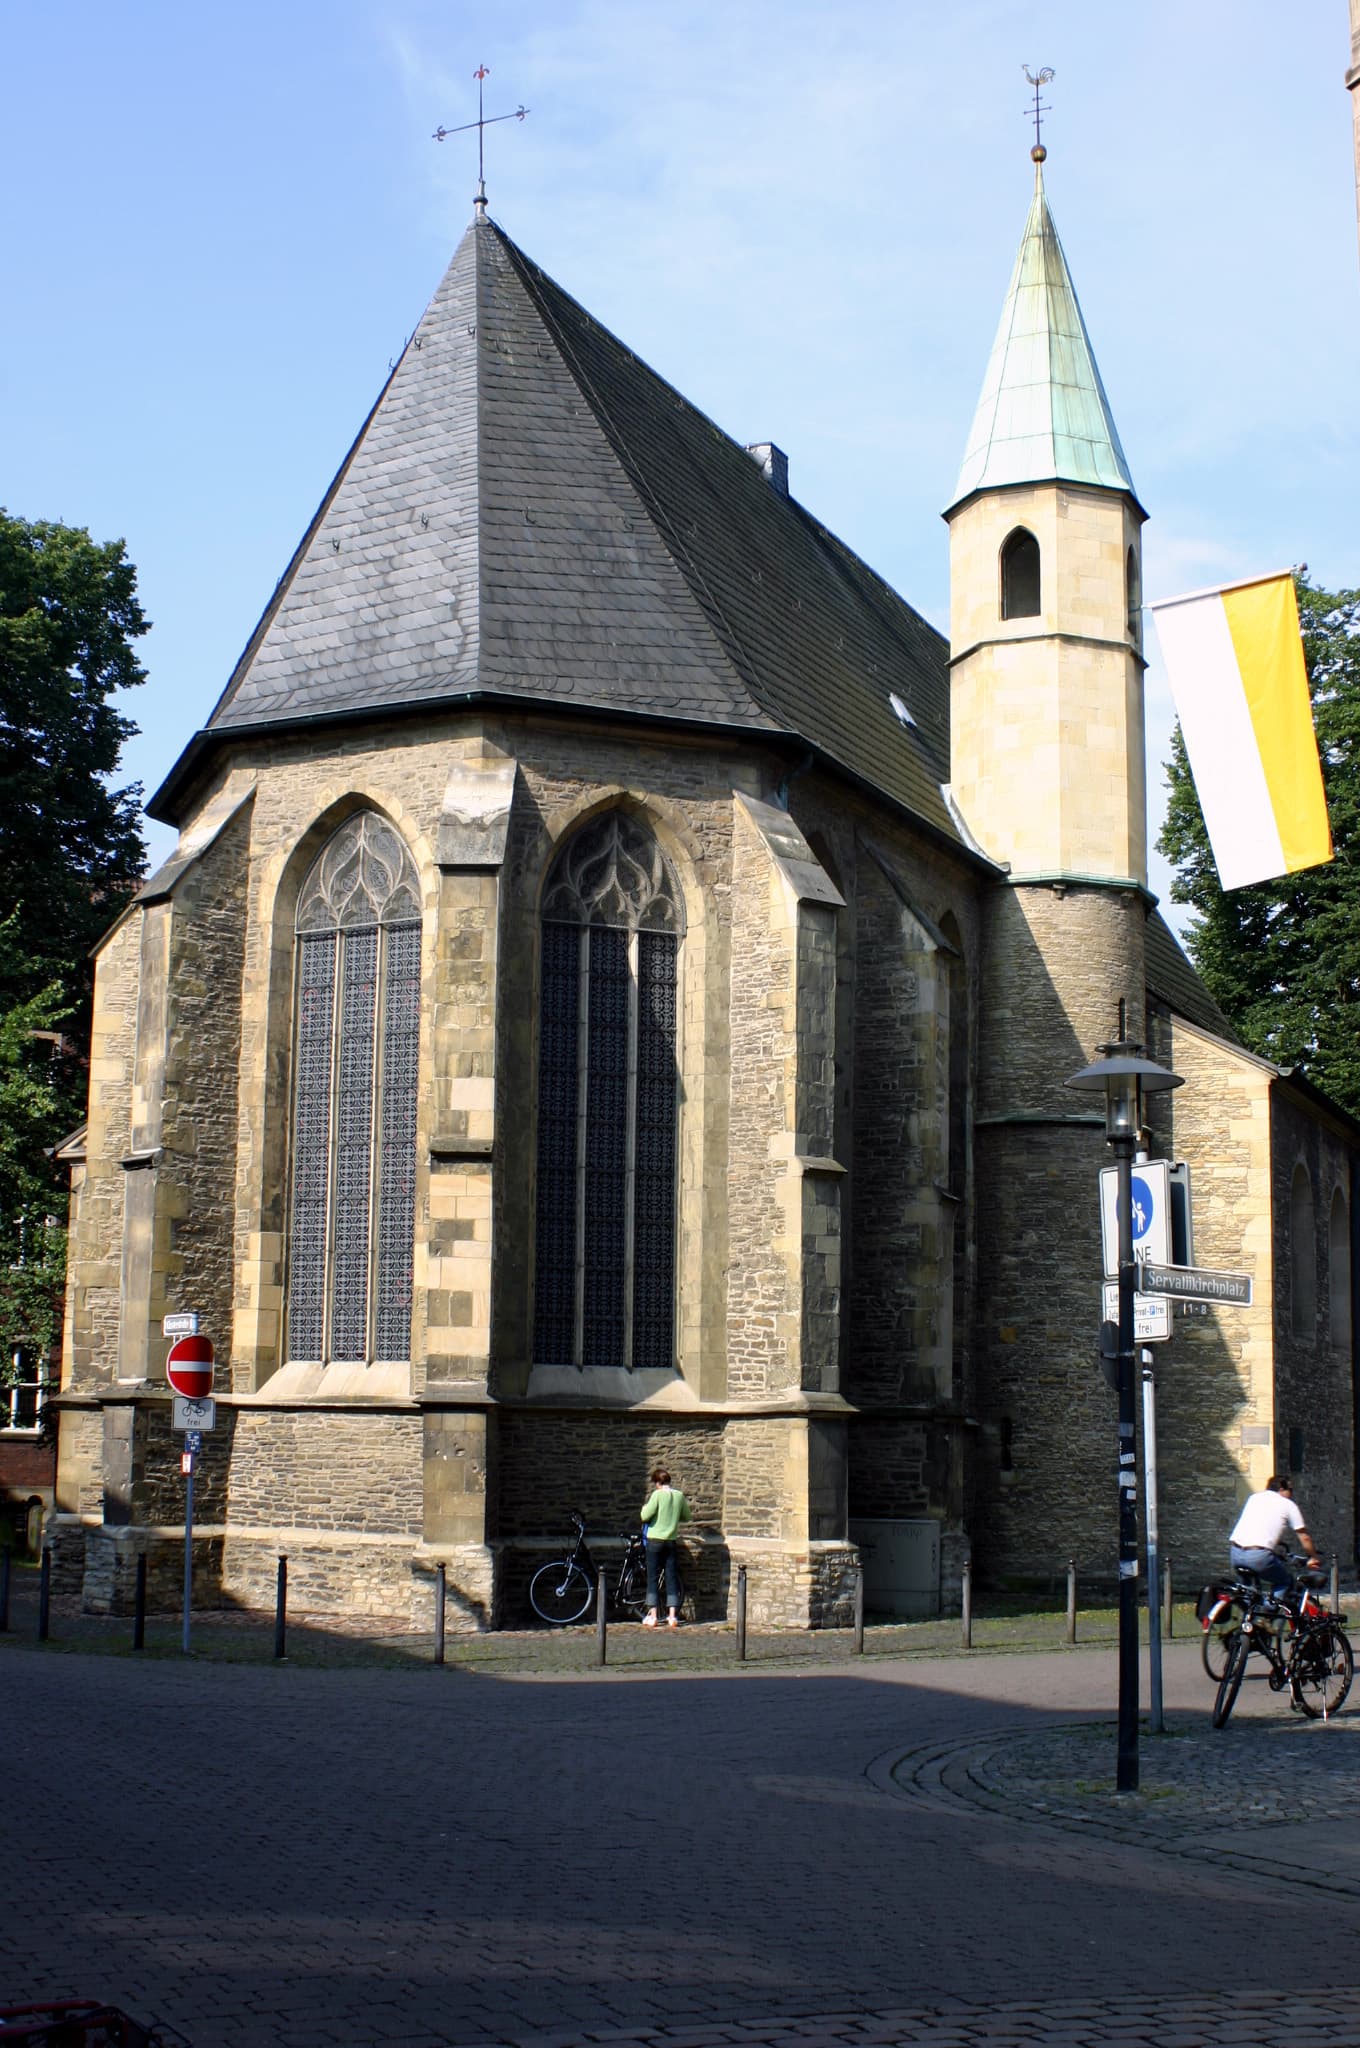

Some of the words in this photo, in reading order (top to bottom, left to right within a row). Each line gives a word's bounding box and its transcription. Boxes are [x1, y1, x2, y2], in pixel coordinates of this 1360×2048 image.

[1135, 1246, 1151, 1263] NE
[1138, 1321, 1153, 1334] frei
[187, 1418, 201, 1426] frei
